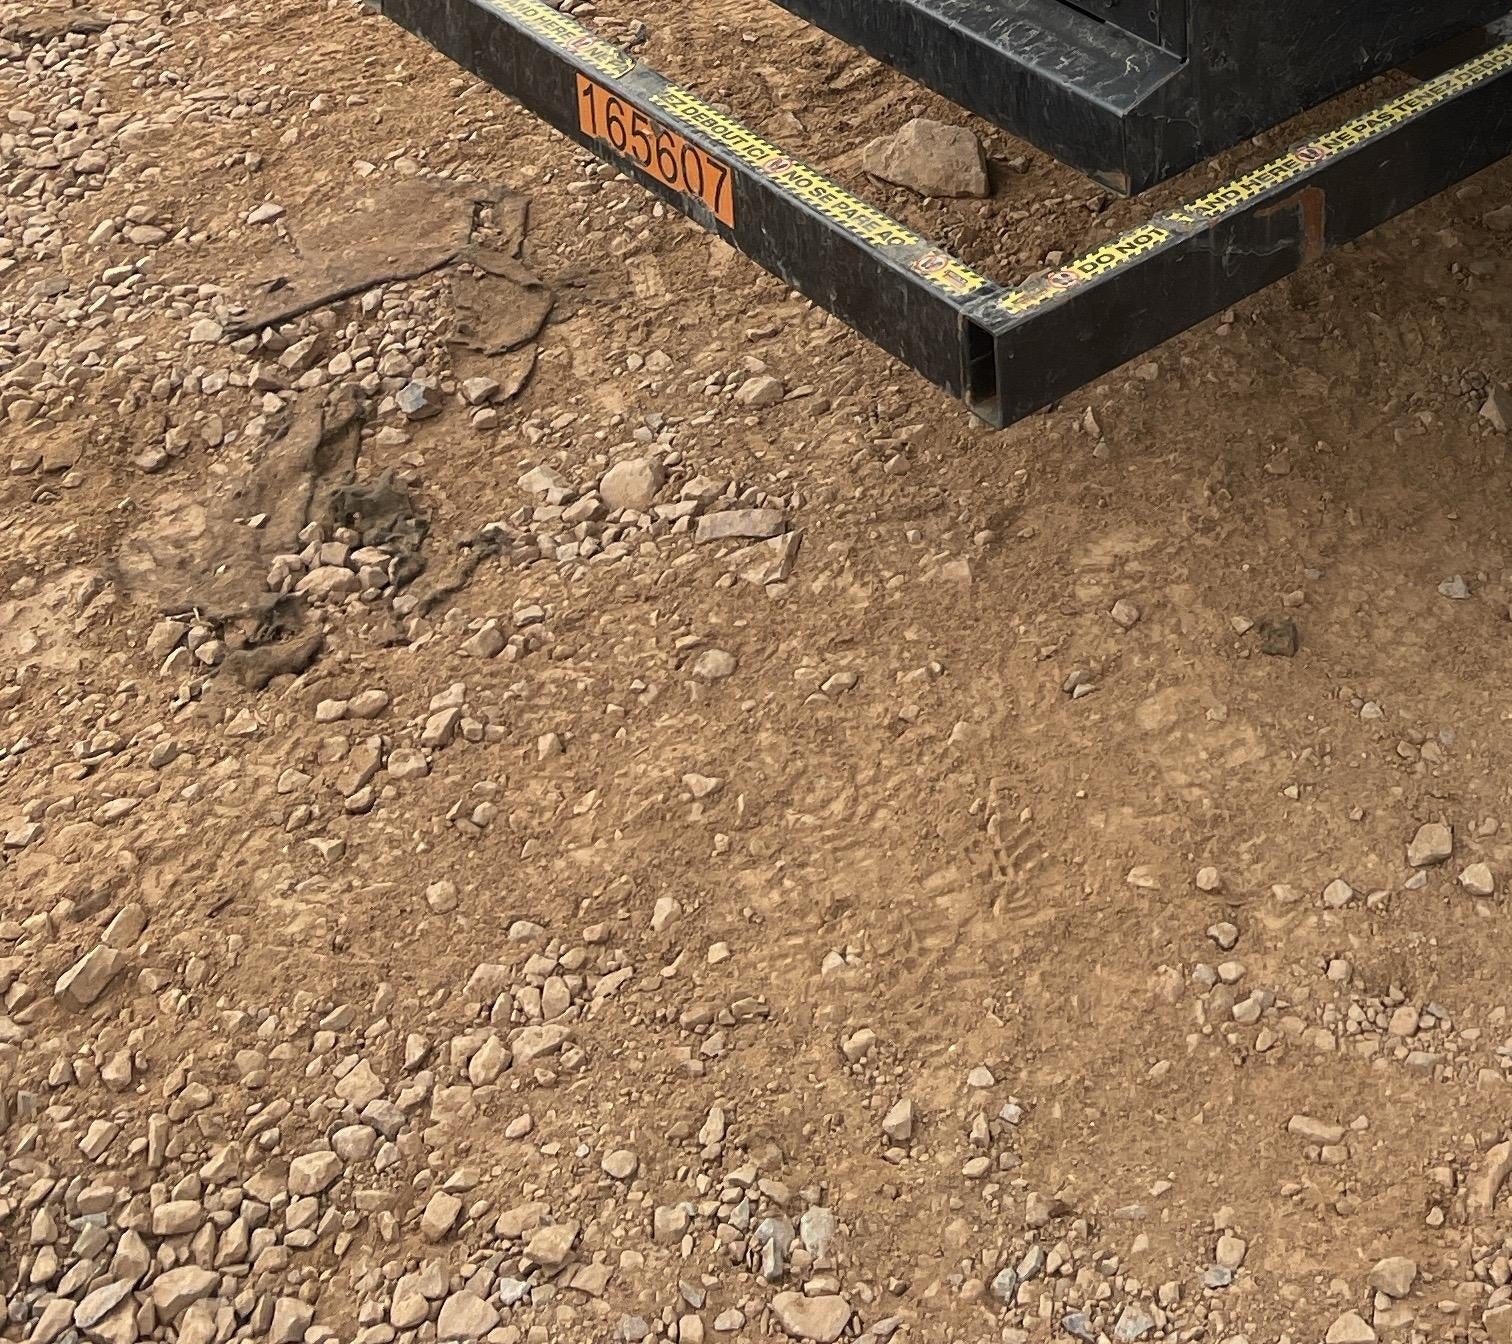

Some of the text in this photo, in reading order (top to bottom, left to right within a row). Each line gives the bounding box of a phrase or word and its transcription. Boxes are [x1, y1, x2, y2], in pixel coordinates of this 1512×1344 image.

[535, 15, 577, 42] HERE
[582, 83, 728, 214] 165607
[681, 104, 746, 146] DEBOUT
[744, 143, 770, 161] ICI
[1322, 130, 1349, 150] NE
[1354, 111, 1394, 135] PAS
[1391, 80, 1454, 114] TENEZ
[783, 169, 812, 188] NO
[808, 186, 839, 204] SE
[831, 200, 882, 233] PARE
[1077, 253, 1116, 274] DO
[1240, 158, 1301, 192] HERE
